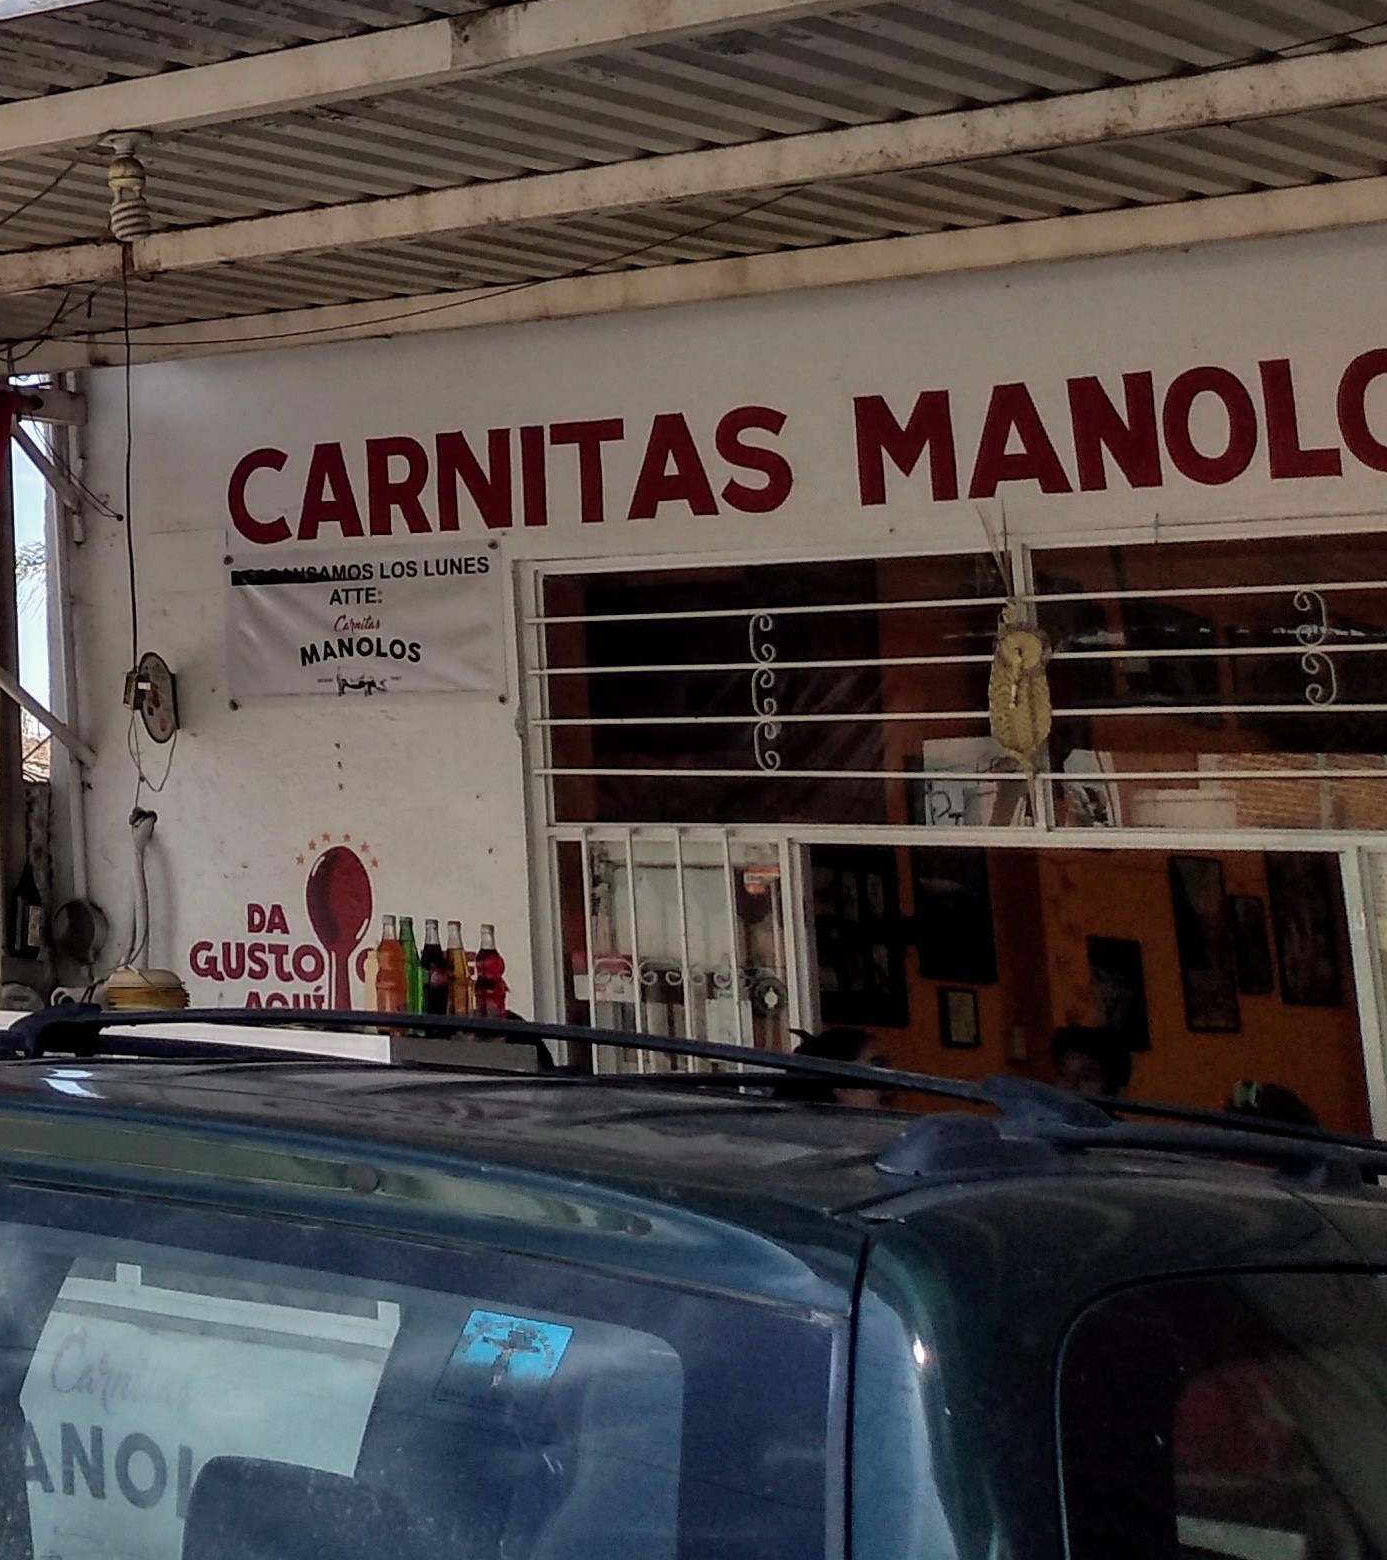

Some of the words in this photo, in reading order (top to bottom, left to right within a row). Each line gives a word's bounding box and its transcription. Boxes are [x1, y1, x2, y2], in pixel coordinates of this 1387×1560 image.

[226, 405, 795, 546] CARNITAS
[379, 560, 418, 580] LOS
[423, 556, 490, 577] LUNES
[329, 587, 383, 606] ATTE:
[333, 613, 381, 633] Carnitas
[299, 636, 422, 667] MANOLOS
[246, 903, 291, 935] DA
[189, 941, 326, 983] GUSTO
